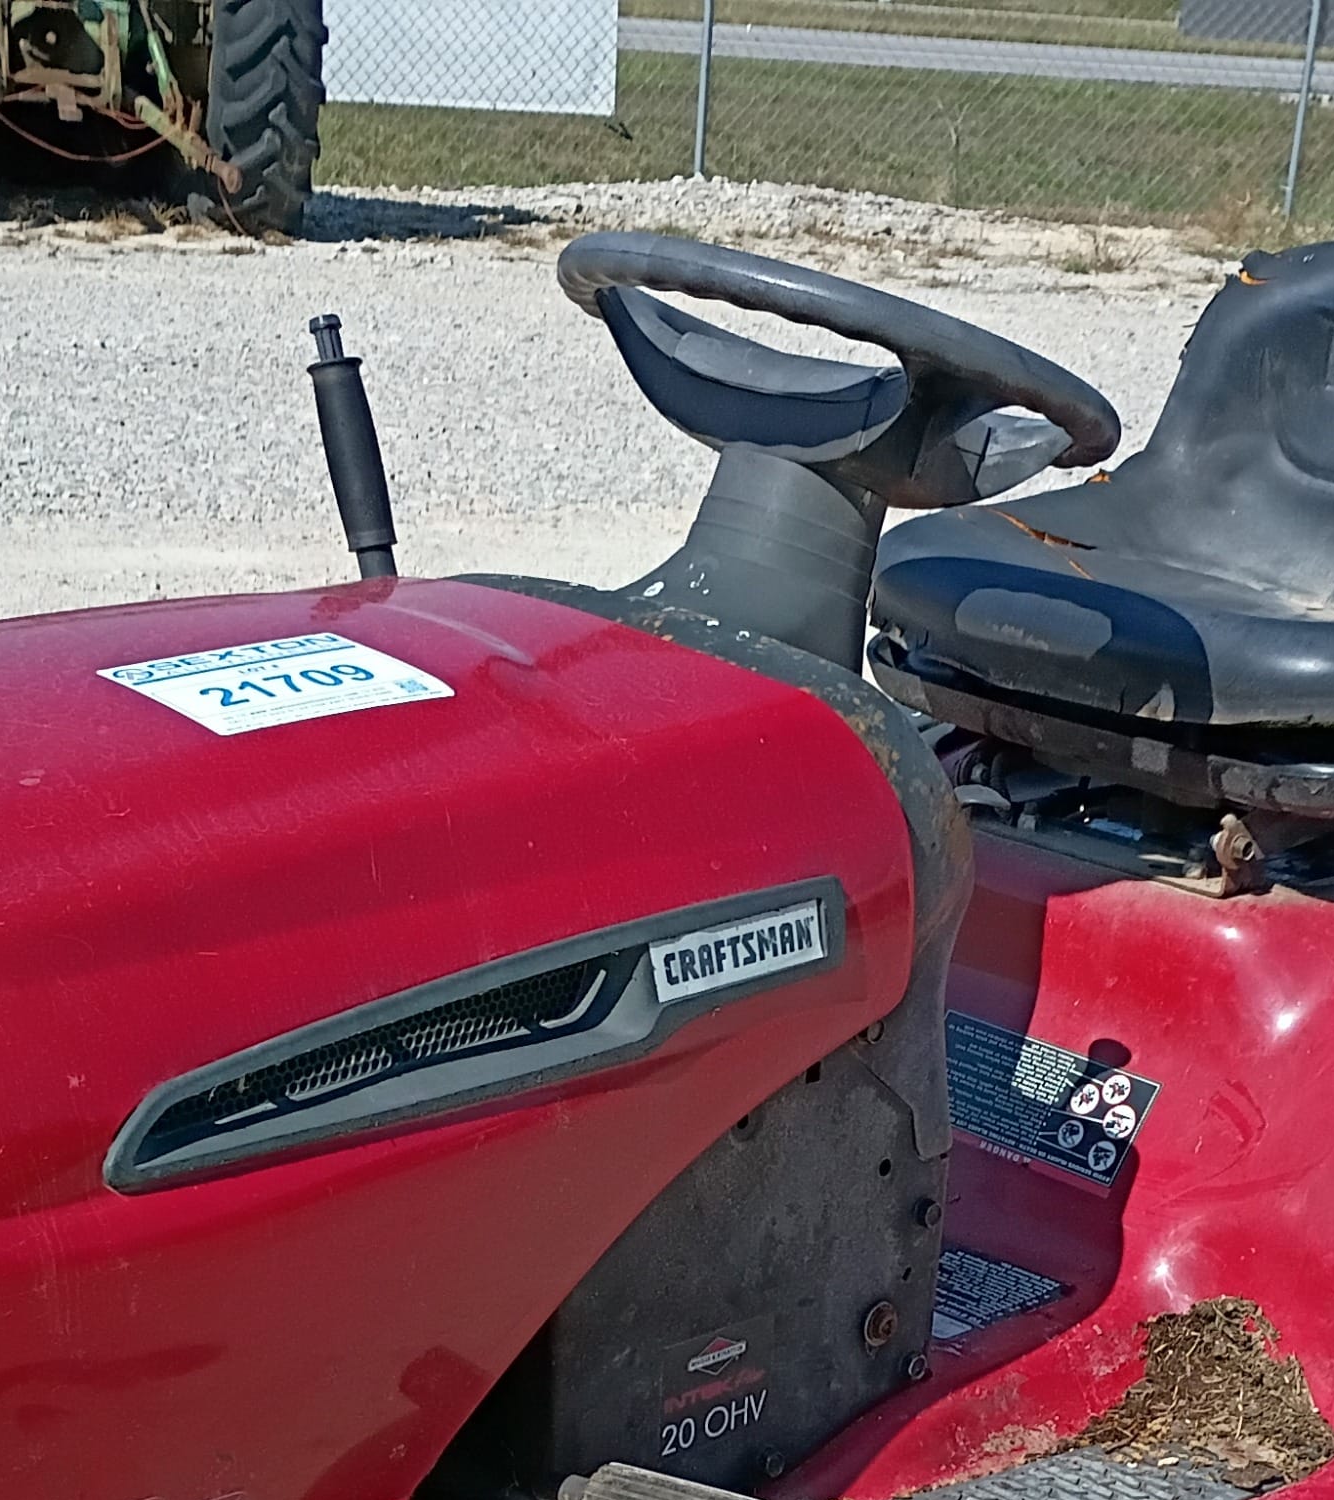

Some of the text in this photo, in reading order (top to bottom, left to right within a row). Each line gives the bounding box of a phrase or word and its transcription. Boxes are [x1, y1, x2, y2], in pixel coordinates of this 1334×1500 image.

[148, 635, 339, 671] SEXTON
[199, 664, 374, 707] 21709
[663, 919, 813, 986] CRAFTSMAN
[979, 1140, 1020, 1162] DANGER
[661, 1389, 767, 1456] 20 OHV
